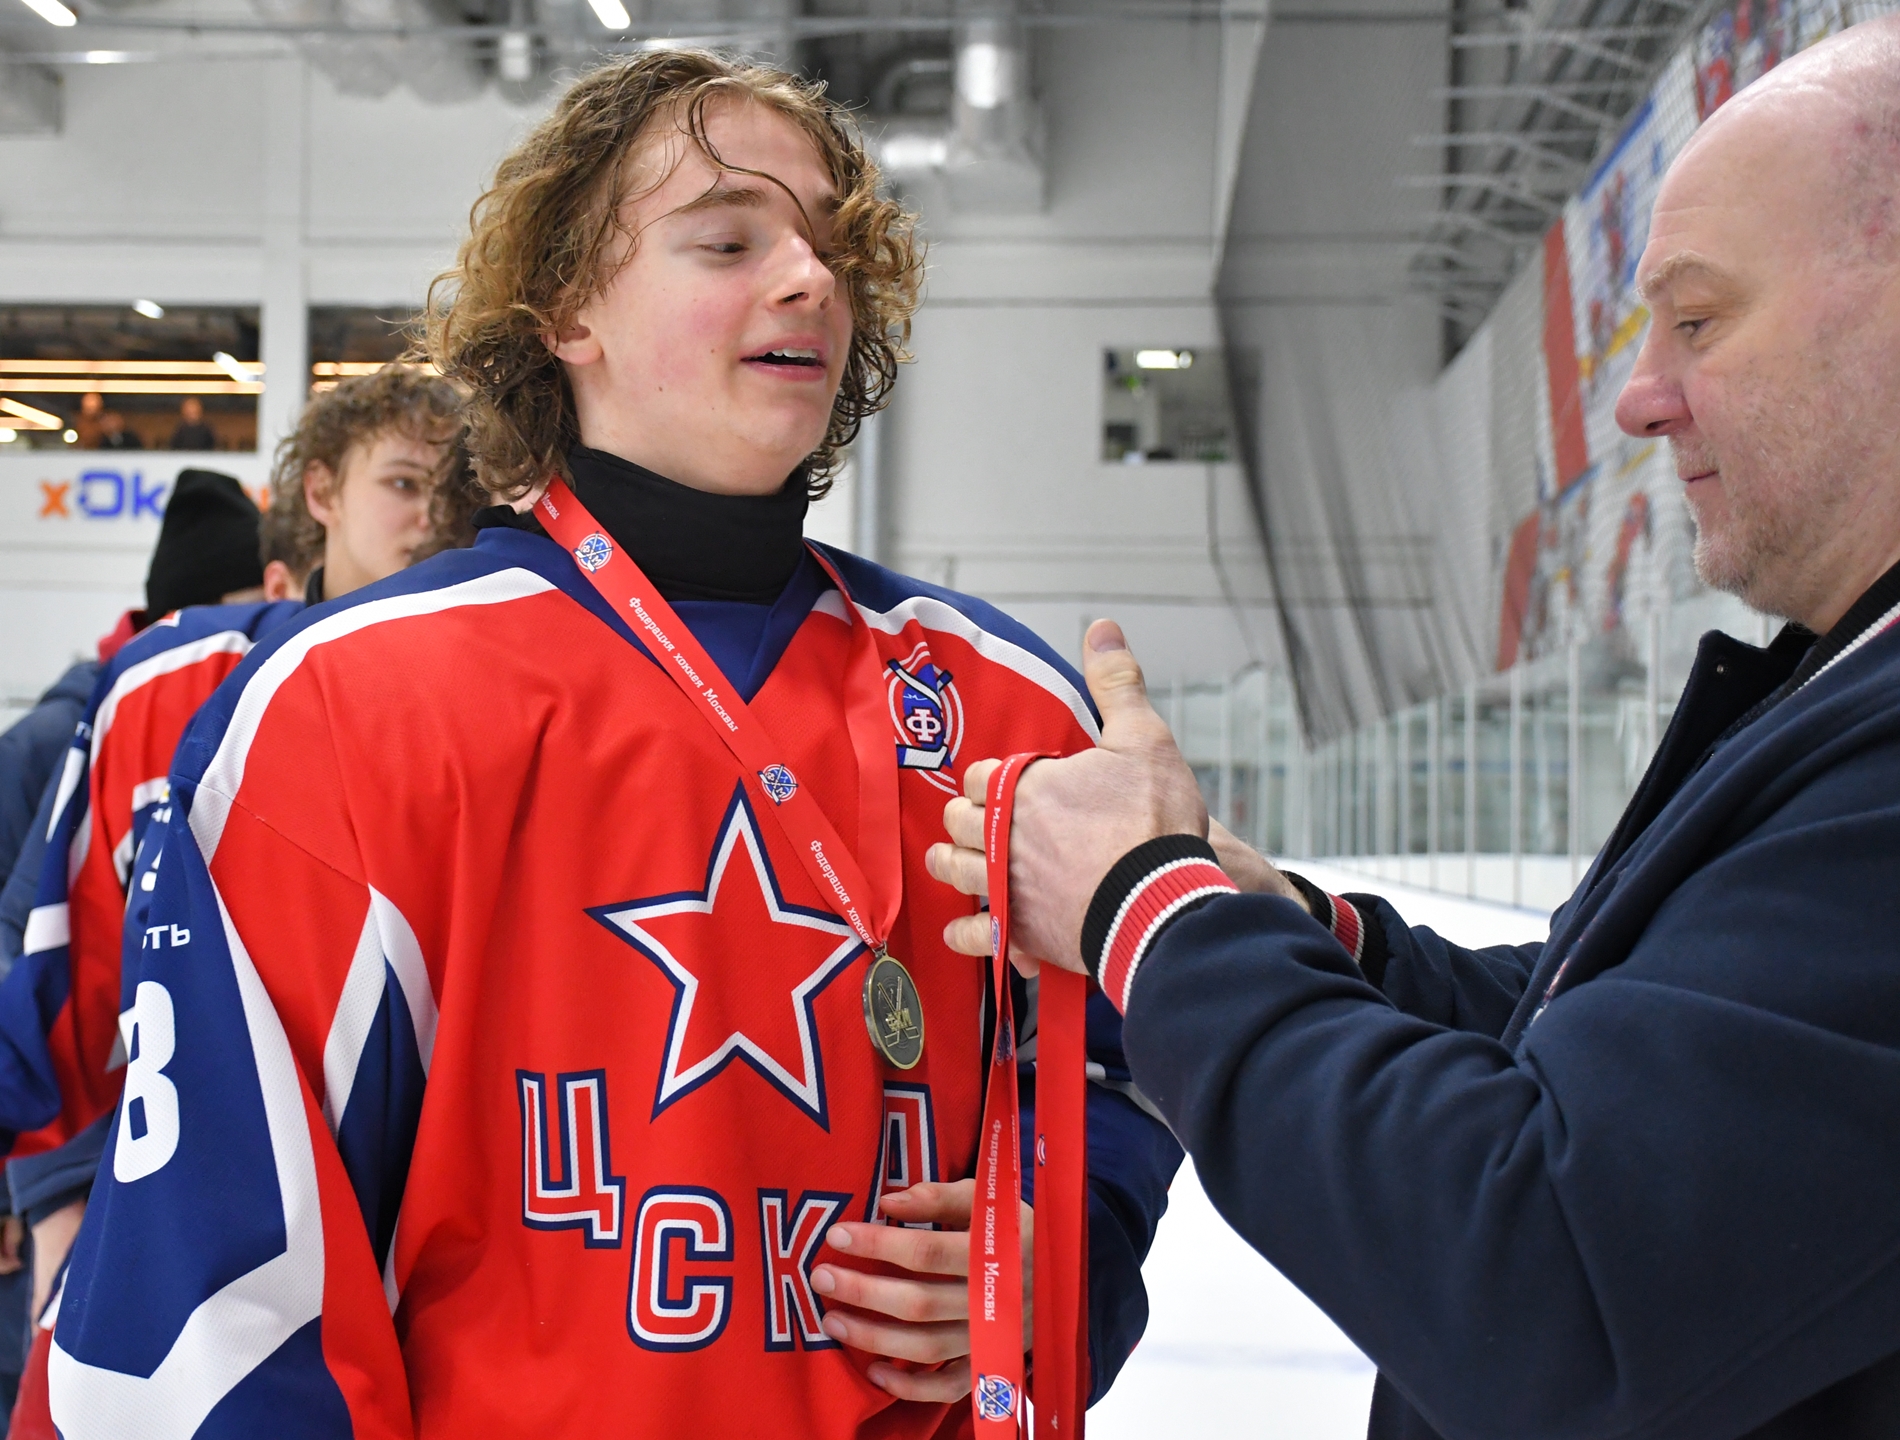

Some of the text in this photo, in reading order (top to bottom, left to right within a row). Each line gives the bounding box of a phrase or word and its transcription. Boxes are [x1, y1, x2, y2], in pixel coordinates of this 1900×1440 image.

[629, 597, 739, 732] Федерация хоккея Москвы
[810, 839, 875, 946] Федерация хоккея
[991, 807, 1001, 863] Москвы
[984, 1119, 1002, 1322] Федерация хоккея Москвы
